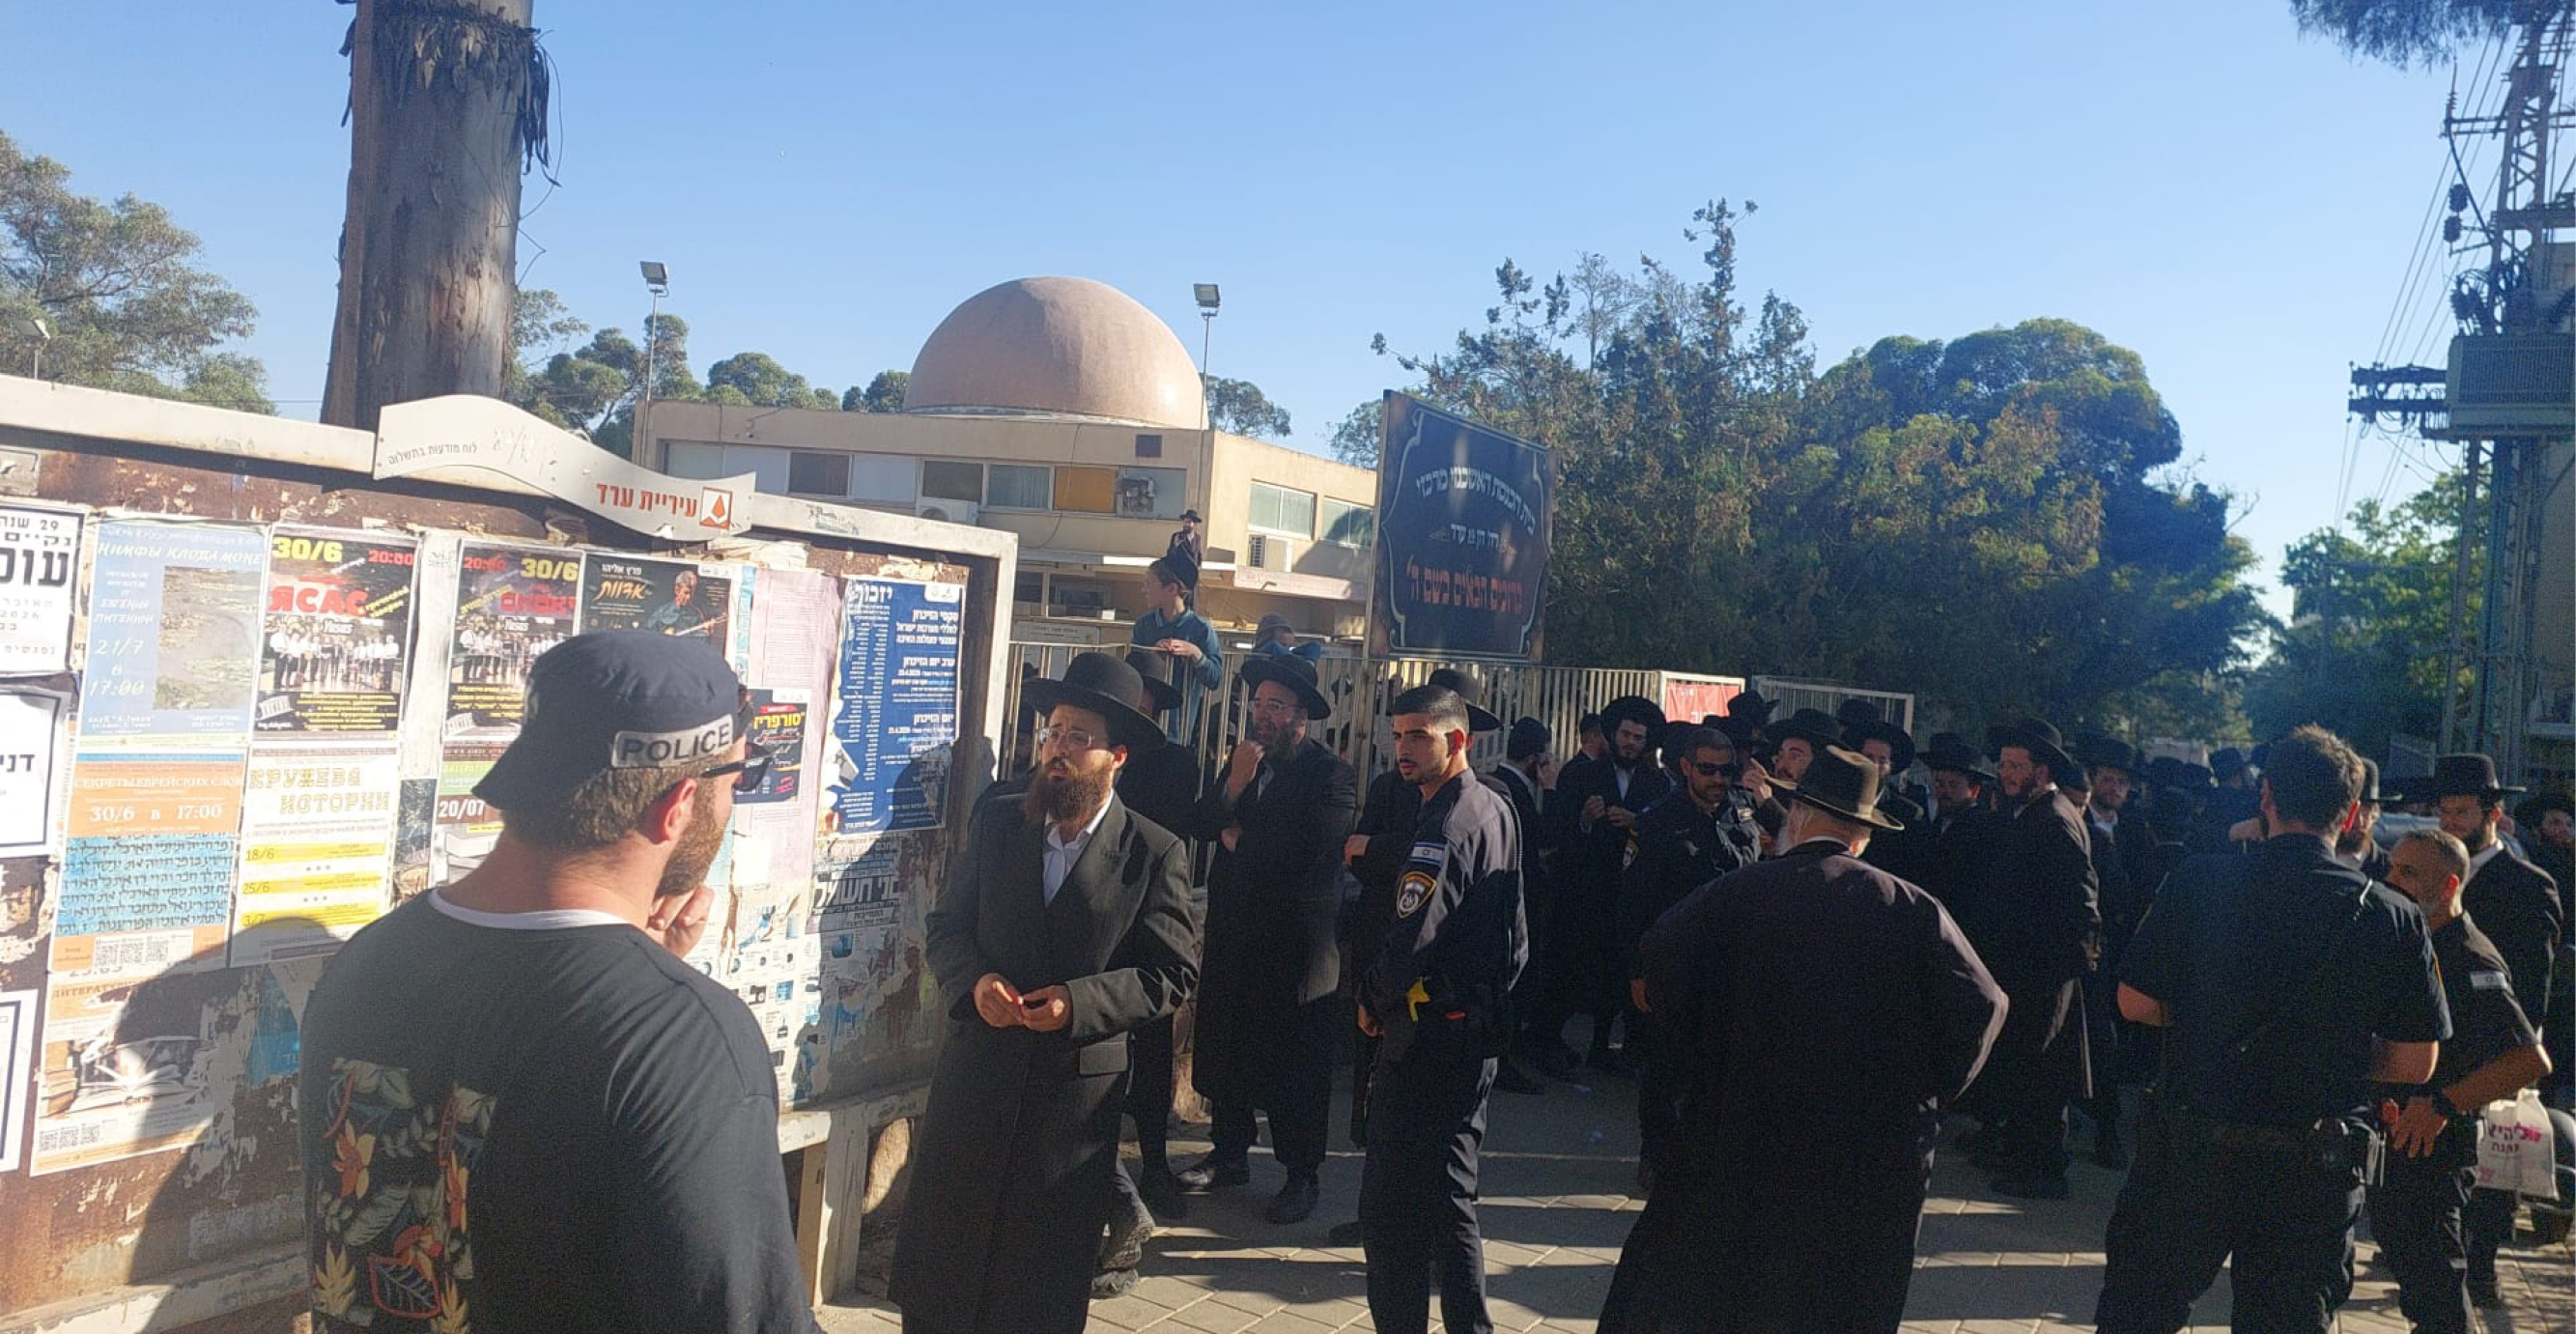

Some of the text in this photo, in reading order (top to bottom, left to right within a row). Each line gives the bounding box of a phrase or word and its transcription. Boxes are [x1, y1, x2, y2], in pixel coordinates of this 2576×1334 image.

[428, 443, 460, 455] מודעות
[463, 441, 477, 454] לוח
[596, 483, 697, 519] עיריית ערד
[41, 519, 60, 531] 29
[98, 541, 162, 558] НИМФЫ
[272, 537, 343, 562] 30/6
[368, 550, 415, 566] 20:00
[521, 557, 580, 582] 30/6
[269, 585, 368, 616] ЯСАС
[95, 638, 144, 657] 21/7
[90, 679, 145, 696] 17:00
[621, 722, 732, 762] POLICE
[248, 767, 362, 789] КРУЖЕВА
[279, 791, 390, 814] ИСТОРИИ
[438, 799, 487, 819] 20/07
[90, 807, 135, 822] 30/6
[178, 805, 222, 820] 17:00
[245, 848, 275, 862] 18/6
[242, 881, 270, 894] 25/6
